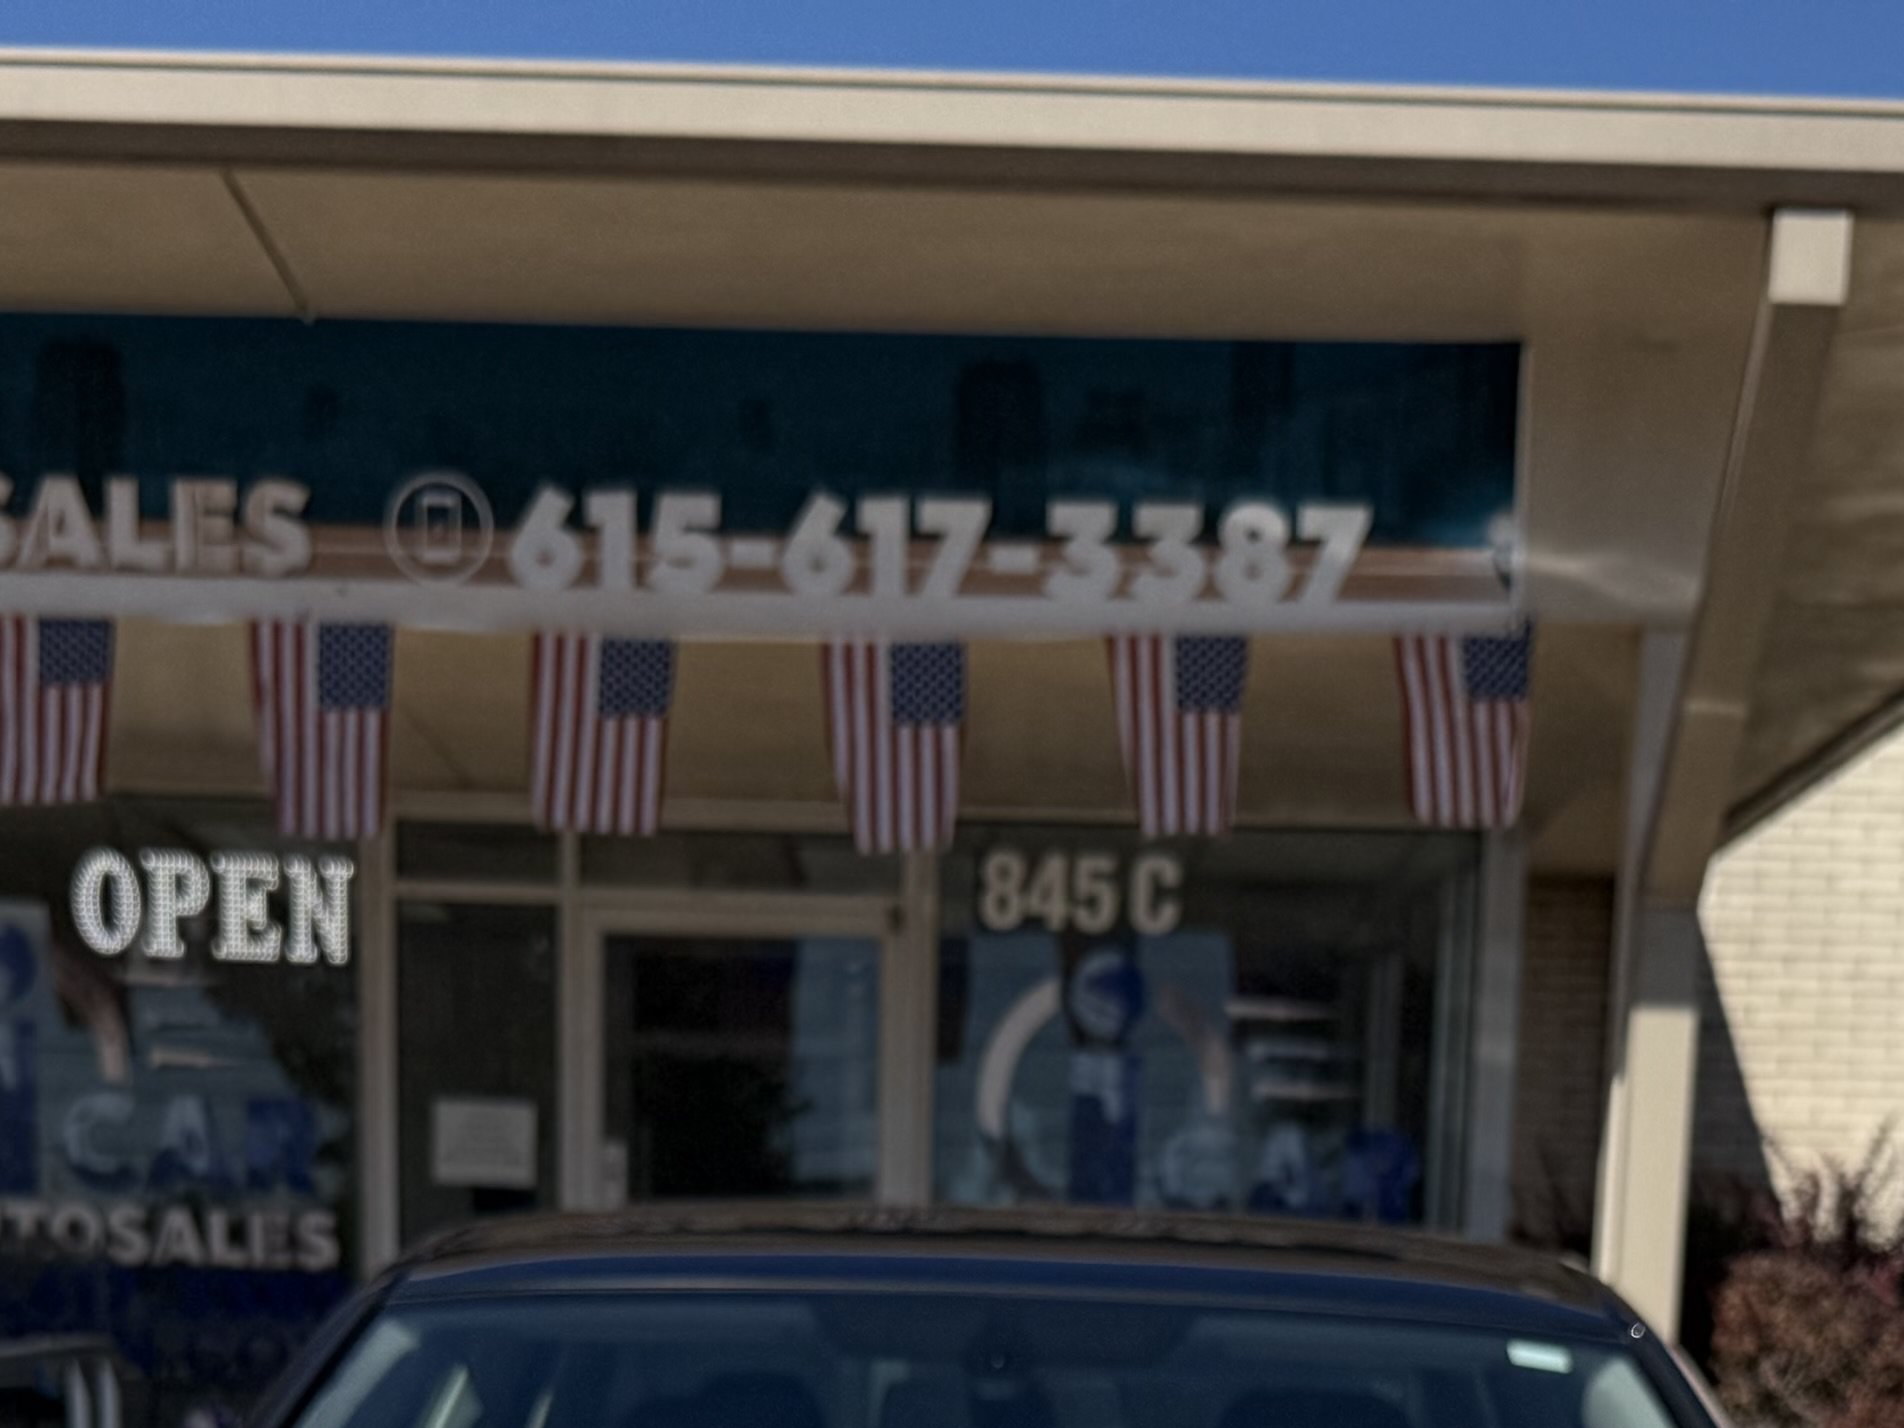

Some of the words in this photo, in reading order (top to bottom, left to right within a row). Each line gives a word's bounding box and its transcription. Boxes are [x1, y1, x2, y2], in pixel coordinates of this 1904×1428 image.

[510, 486, 1373, 606] 615-617-3387
[69, 846, 354, 964] OPEN
[981, 849, 1119, 935] 845
[1128, 854, 1183, 936] C
